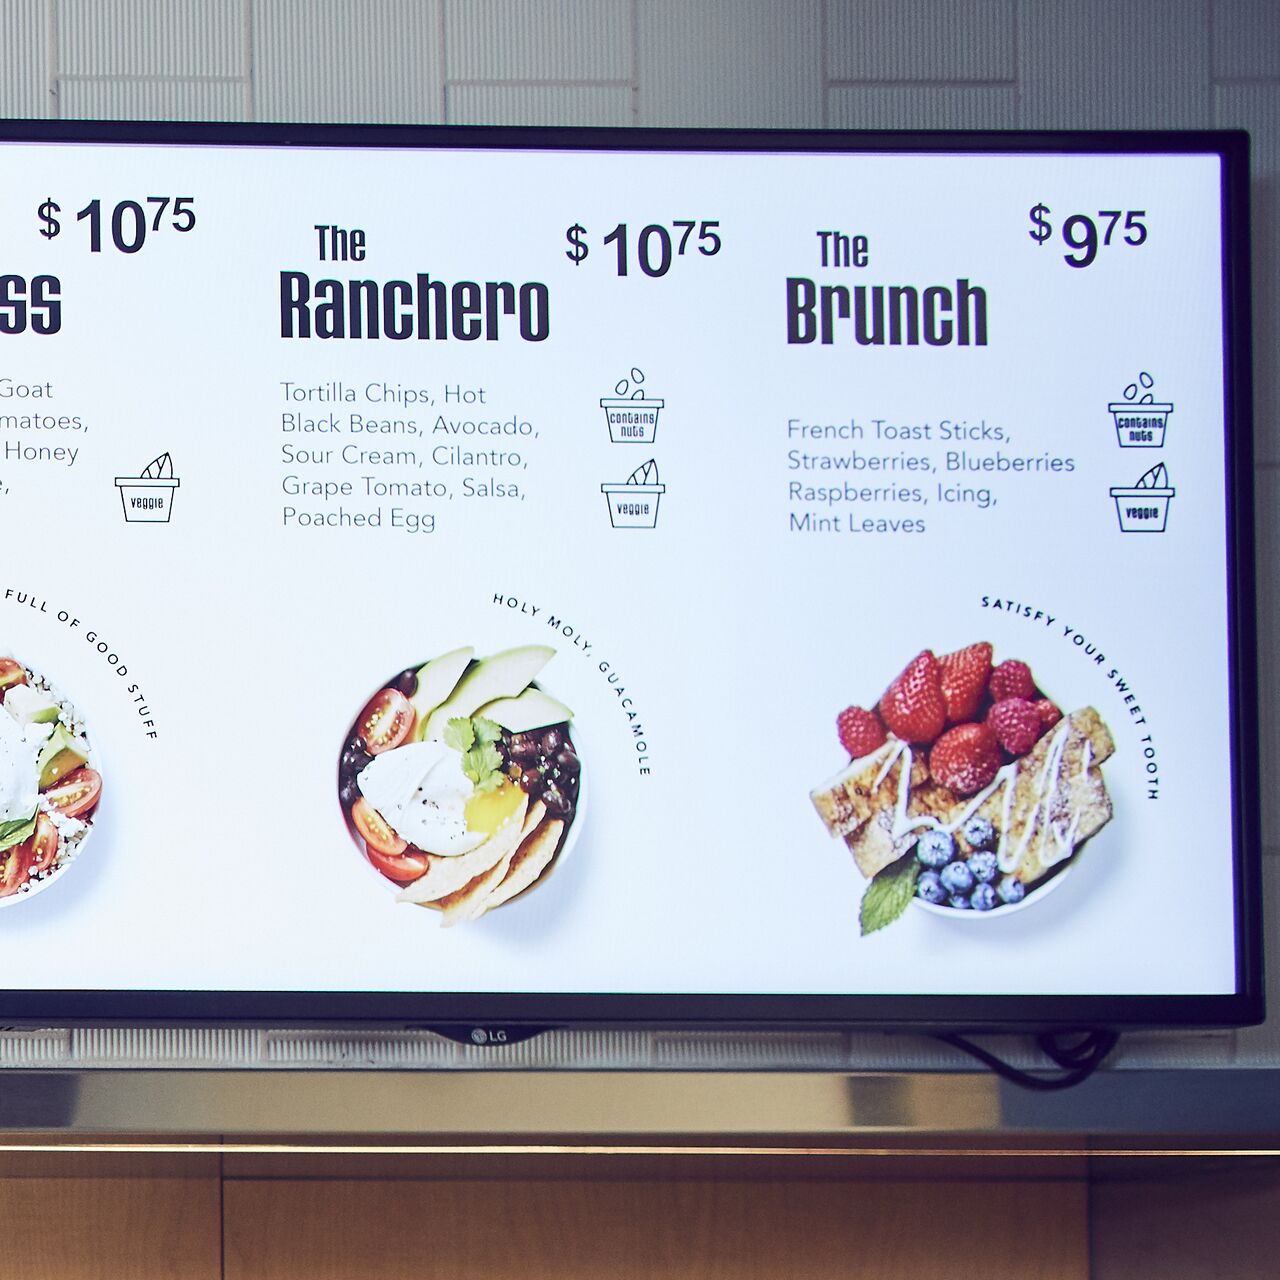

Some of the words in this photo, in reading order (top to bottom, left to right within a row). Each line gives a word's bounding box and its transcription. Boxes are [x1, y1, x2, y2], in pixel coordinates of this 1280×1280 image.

[38, 197, 61, 240] $
[1029, 203, 1052, 246] $
[314, 225, 366, 261] The
[566, 223, 589, 266] $
[816, 231, 868, 268] The
[280, 271, 550, 342] Ranchero
[786, 277, 988, 346] Brunch
[280, 382, 356, 402] Tortilla
[365, 383, 435, 408] Chips,
[445, 384, 486, 404] Hot
[282, 412, 341, 433] Black
[350, 414, 423, 437] Beans,
[432, 415, 539, 438] Avocado,
[609, 412, 655, 425] contains
[621, 425, 644, 437] nuts
[788, 419, 863, 439] French
[871, 420, 931, 440] Toast
[939, 420, 1010, 444] Sticks,
[1118, 416, 1164, 430] contains
[1129, 430, 1153, 442] nuts
[5, 441, 79, 467] Honey
[282, 444, 333, 464] Sour
[342, 444, 422, 468] Cream,
[432, 445, 527, 469] Cilantro,
[788, 450, 936, 474] Strawberries,
[946, 451, 1075, 472] Blueberries
[282, 475, 353, 501] Grape
[361, 476, 453, 500] Tomato,
[463, 477, 525, 500] Salsa,
[789, 481, 928, 506] Raspberries,
[938, 483, 997, 509] Icing,
[131, 497, 163, 510] veggie
[617, 504, 649, 516] veggie
[1126, 507, 1158, 520] veggie
[283, 507, 381, 527] Poached
[391, 508, 435, 533] Egg
[790, 512, 840, 532] Mint
[849, 513, 926, 533] Leaves
[5, 588, 47, 613] FULL
[57, 610, 81, 628] OF
[86, 631, 128, 677] GOOD
[127, 684, 158, 739] STUFF
[493, 593, 540, 617] HOLY
[547, 615, 593, 658] MOLY,
[598, 661, 651, 776] GUACAMOLE
[981, 596, 1056, 627] SATISFY
[1063, 626, 1106, 665] YOUR
[1107, 669, 1146, 725] SWEET
[1141, 734, 1159, 800] TOOTH
